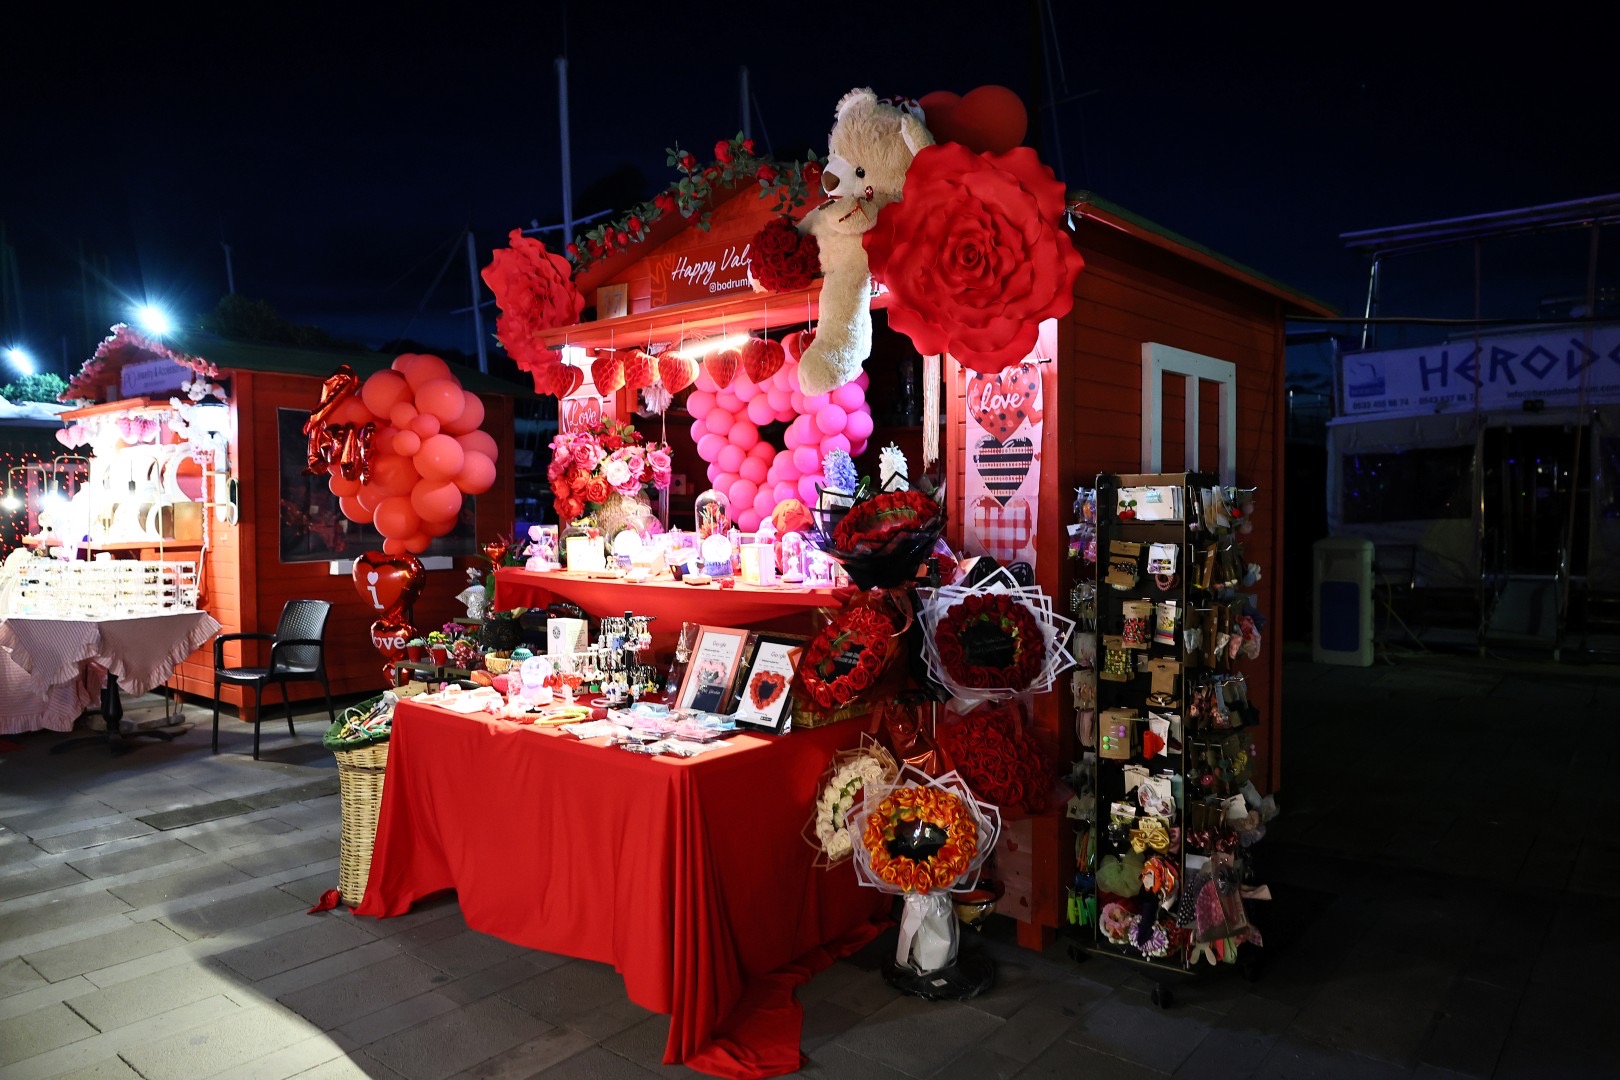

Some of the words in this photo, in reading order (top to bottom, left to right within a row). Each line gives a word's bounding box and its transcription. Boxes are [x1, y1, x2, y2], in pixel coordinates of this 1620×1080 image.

[671, 256, 717, 286] Happy
[980, 382, 1025, 413] love
[570, 401, 597, 426] Love
[366, 571, 385, 610] i
[712, 640, 727, 648] Gogle
[770, 650, 786, 660] Gogle
